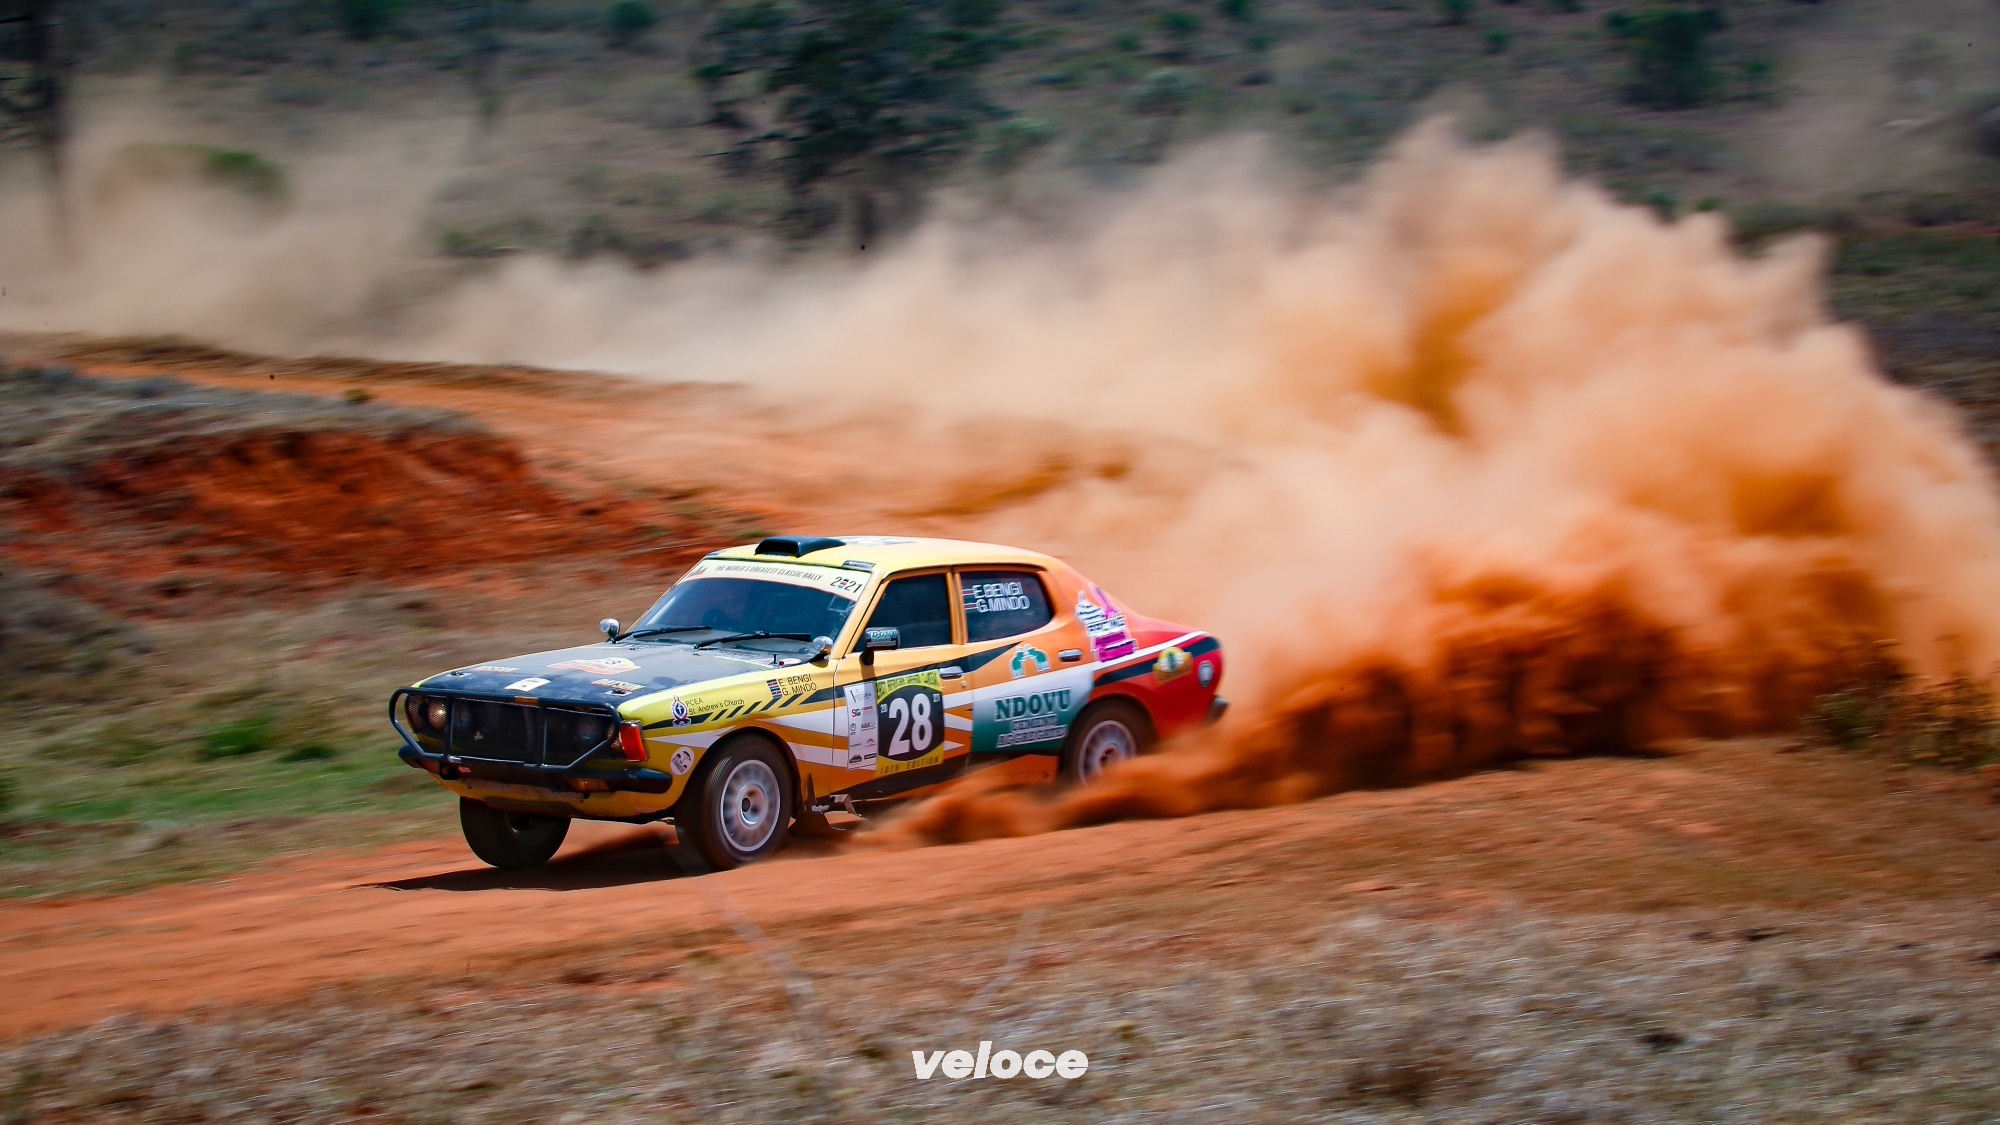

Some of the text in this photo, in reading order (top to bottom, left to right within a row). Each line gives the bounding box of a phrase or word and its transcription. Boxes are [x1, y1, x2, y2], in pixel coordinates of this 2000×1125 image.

[777, 568, 804, 577] CLASSIC
[802, 572, 823, 581] RALLY
[789, 674, 812, 685] BENGI
[792, 683, 817, 695] MINDO
[686, 698, 703, 707] PCEA
[698, 701, 723, 714] Andrew's
[723, 699, 745, 709] Church
[995, 689, 1071, 721] NDOVU
[888, 693, 933, 756] 28
[880, 756, 939, 775] 10TH EDITION
